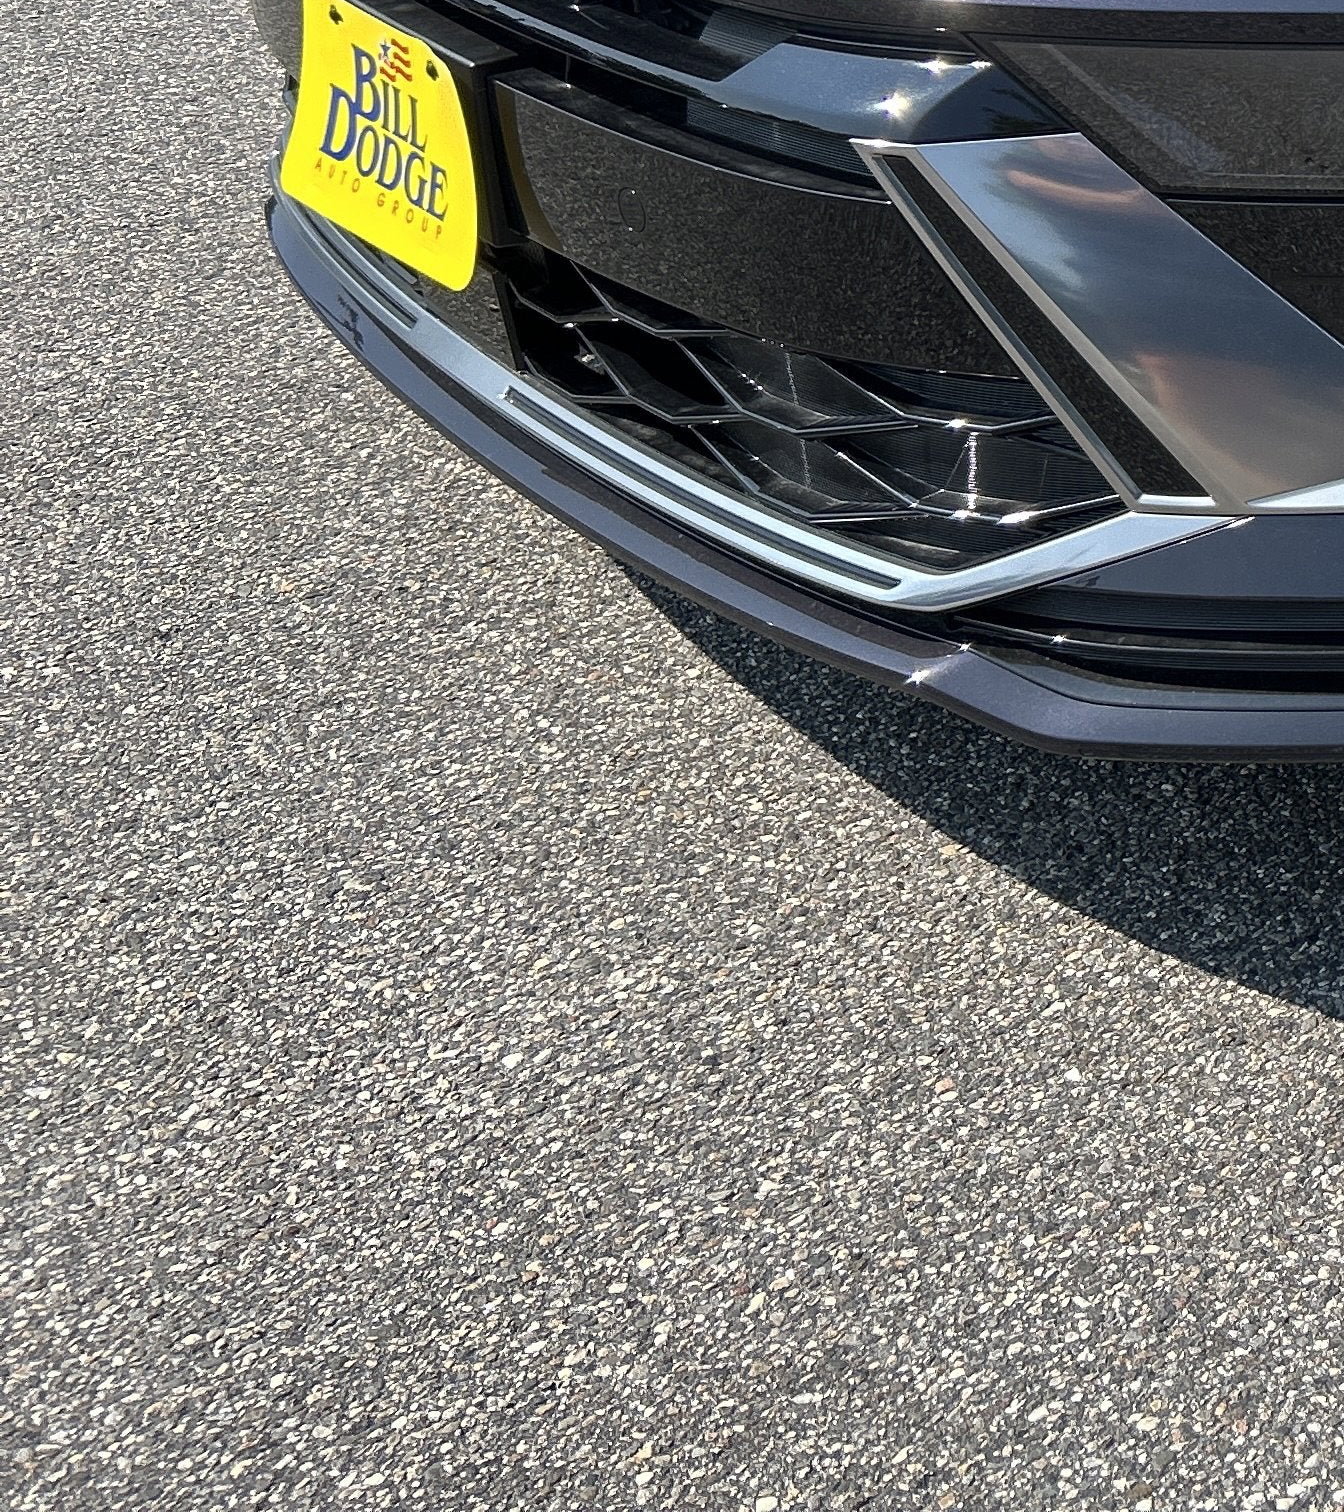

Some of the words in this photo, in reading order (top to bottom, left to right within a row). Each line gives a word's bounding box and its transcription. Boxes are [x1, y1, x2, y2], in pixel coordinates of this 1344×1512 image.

[319, 82, 449, 223] DODGE
[351, 42, 428, 154] BILL
[314, 157, 361, 193] AUTO
[376, 192, 443, 239] GROUP
